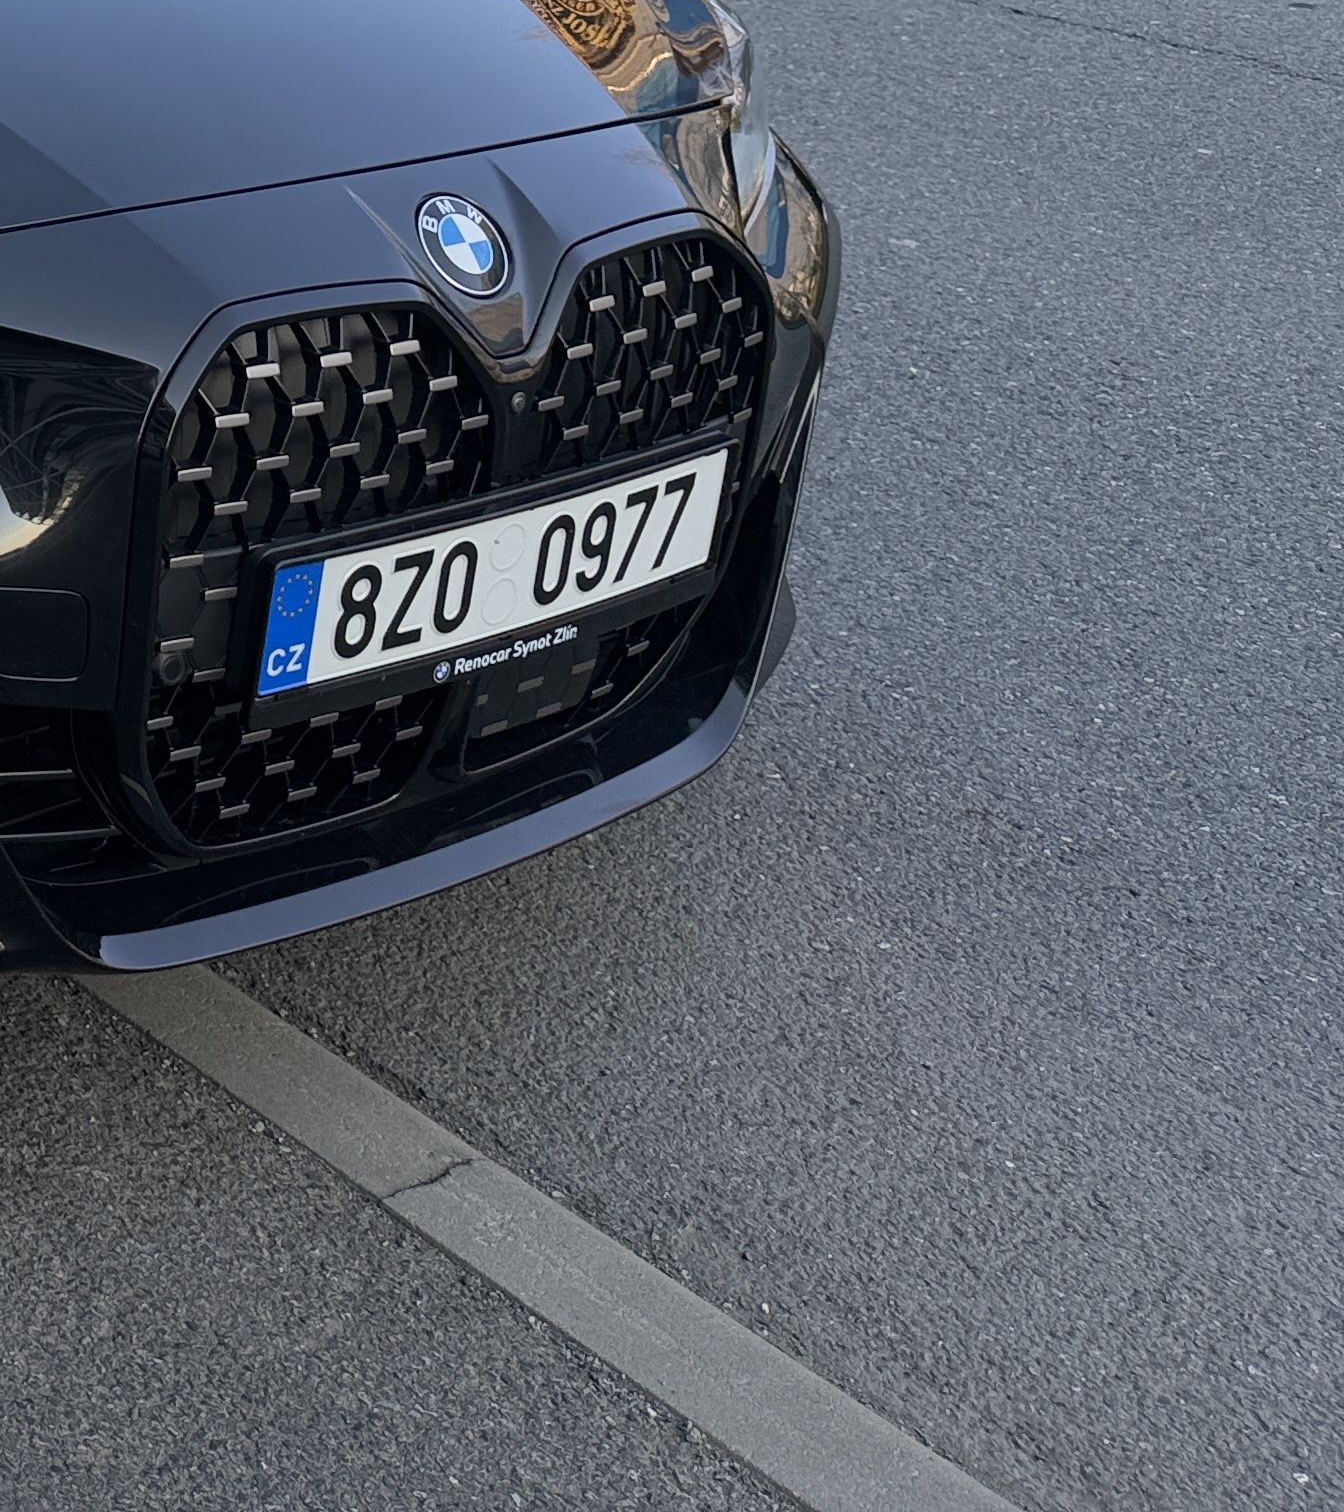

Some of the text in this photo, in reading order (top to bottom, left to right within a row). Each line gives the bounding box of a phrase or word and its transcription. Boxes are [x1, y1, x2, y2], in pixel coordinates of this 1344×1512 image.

[422, 199, 484, 234] BMW
[334, 472, 697, 660] 8Z0 0977
[267, 643, 305, 677] CZ
[454, 648, 512, 675] Renocar
[512, 633, 552, 658] Synot
